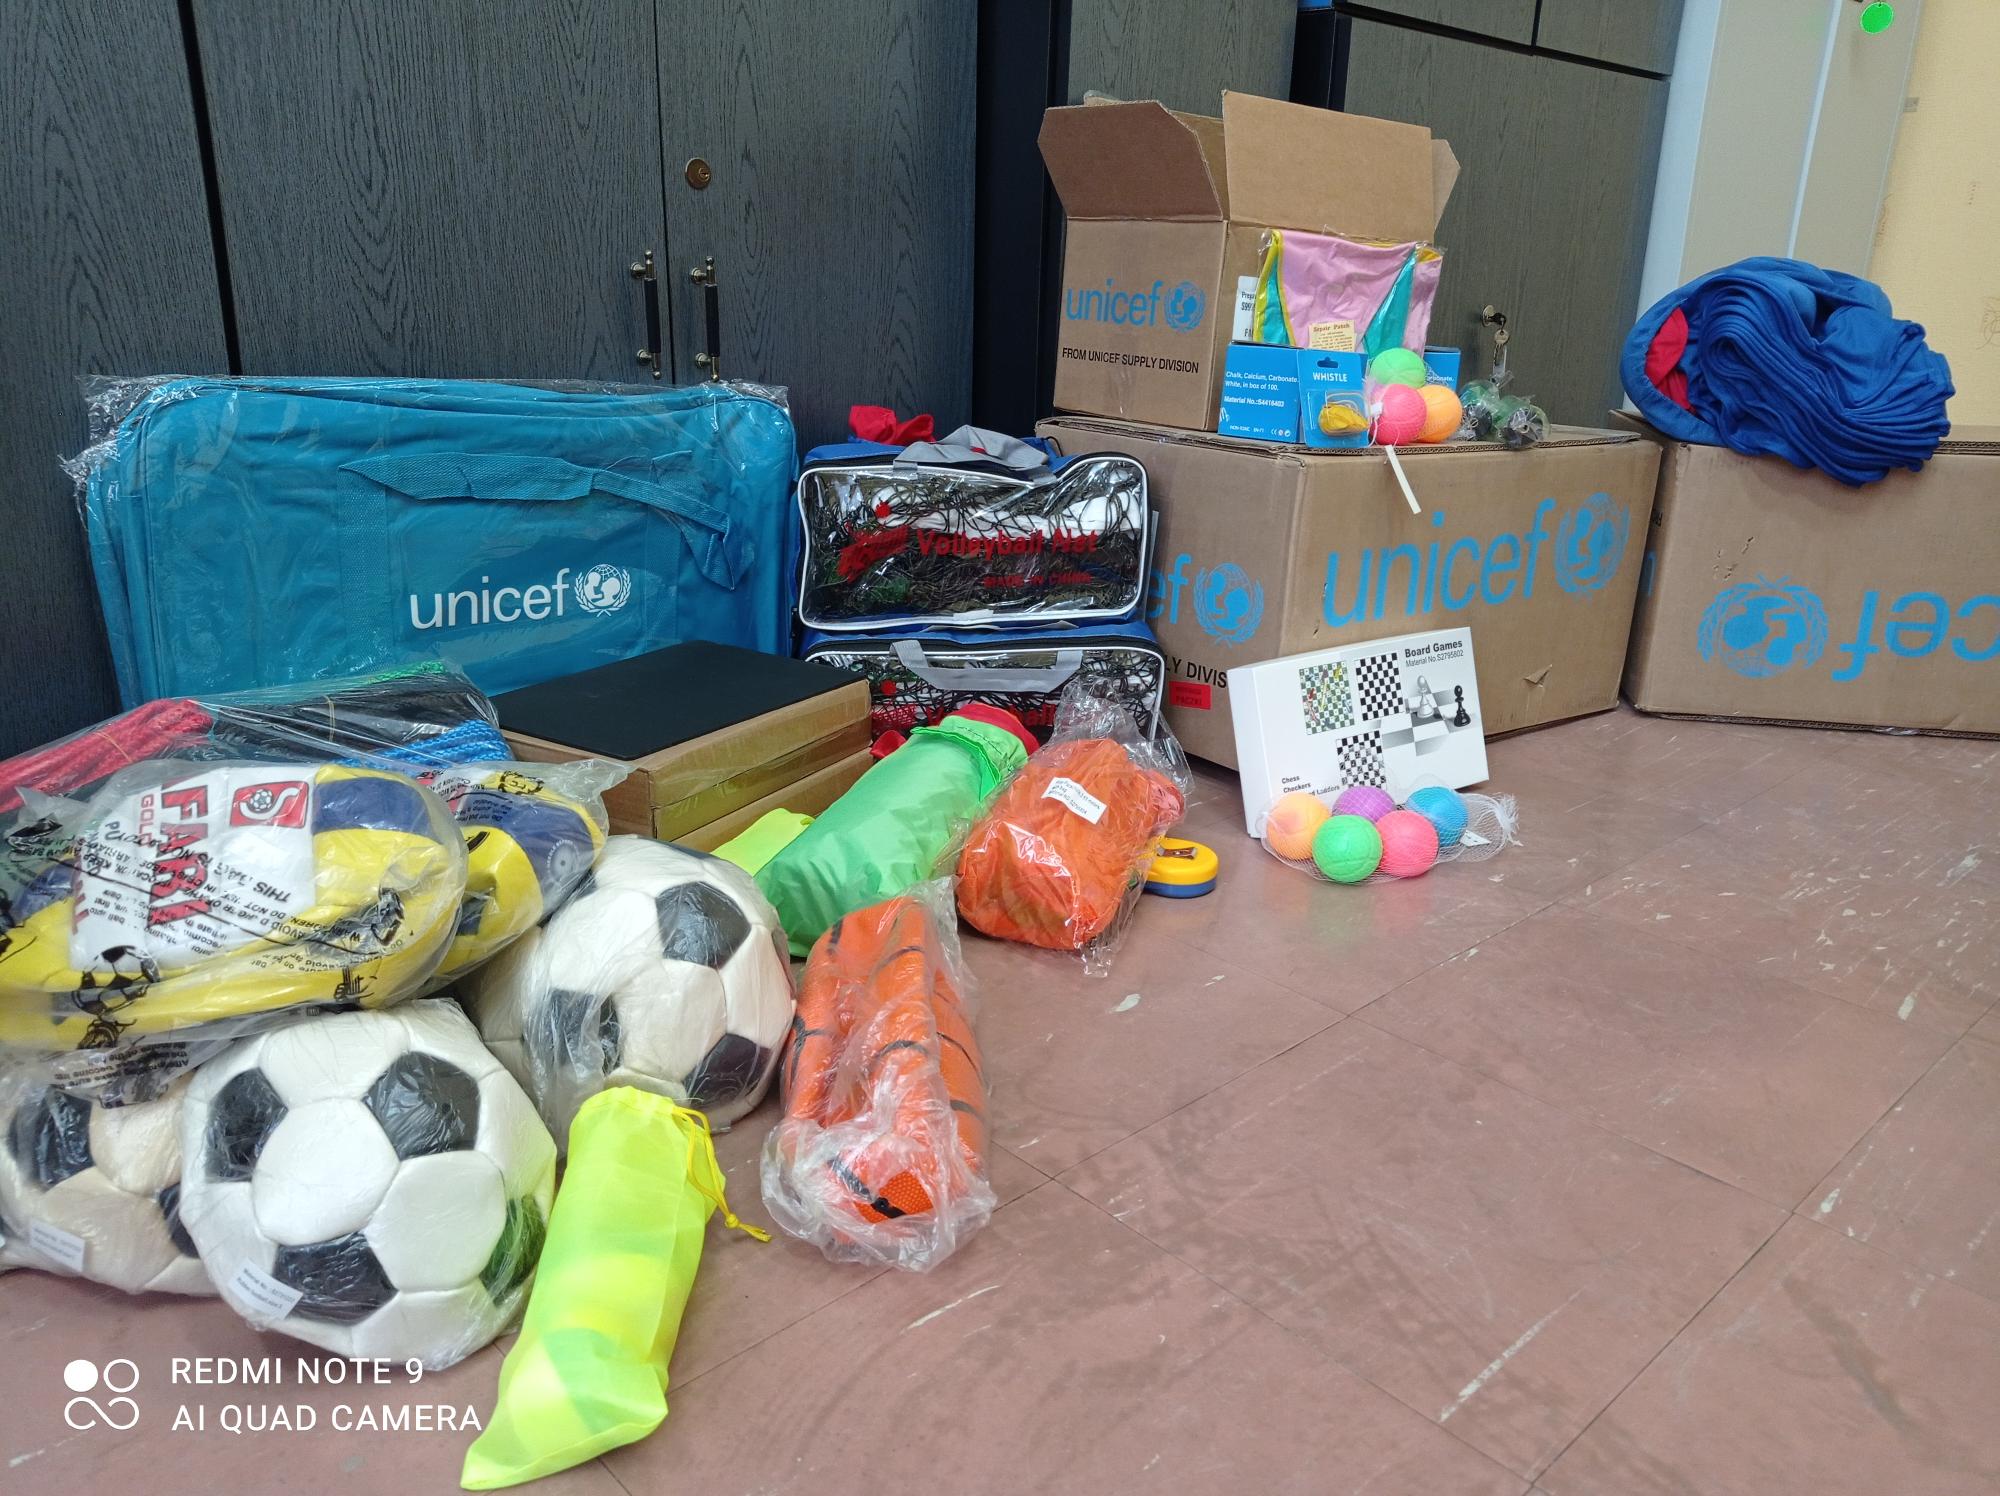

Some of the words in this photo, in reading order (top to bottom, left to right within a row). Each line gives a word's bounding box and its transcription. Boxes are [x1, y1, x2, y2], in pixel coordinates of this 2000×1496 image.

[1066, 278, 1164, 326] unicef
[1062, 347, 1086, 361] FROM
[1088, 350, 1120, 364] UNICEF
[1121, 354, 1158, 369] SUPPLY
[1159, 359, 1199, 374] DIVISION
[1313, 372, 1348, 382] WHISTLE
[1224, 396, 1245, 405] Material
[917, 528, 1043, 561] Volleyball
[1052, 527, 1099, 554] Net
[1323, 498, 1557, 628] unicef
[410, 567, 570, 630] unicef
[1405, 644, 1430, 658] Board
[1433, 640, 1462, 652] Games
[1405, 656, 1427, 667] Material
[1281, 775, 1300, 784] Chess
[1283, 782, 1311, 793] Checkers
[1317, 785, 1340, 795] Ladders
[252, 880, 291, 903] THIS
